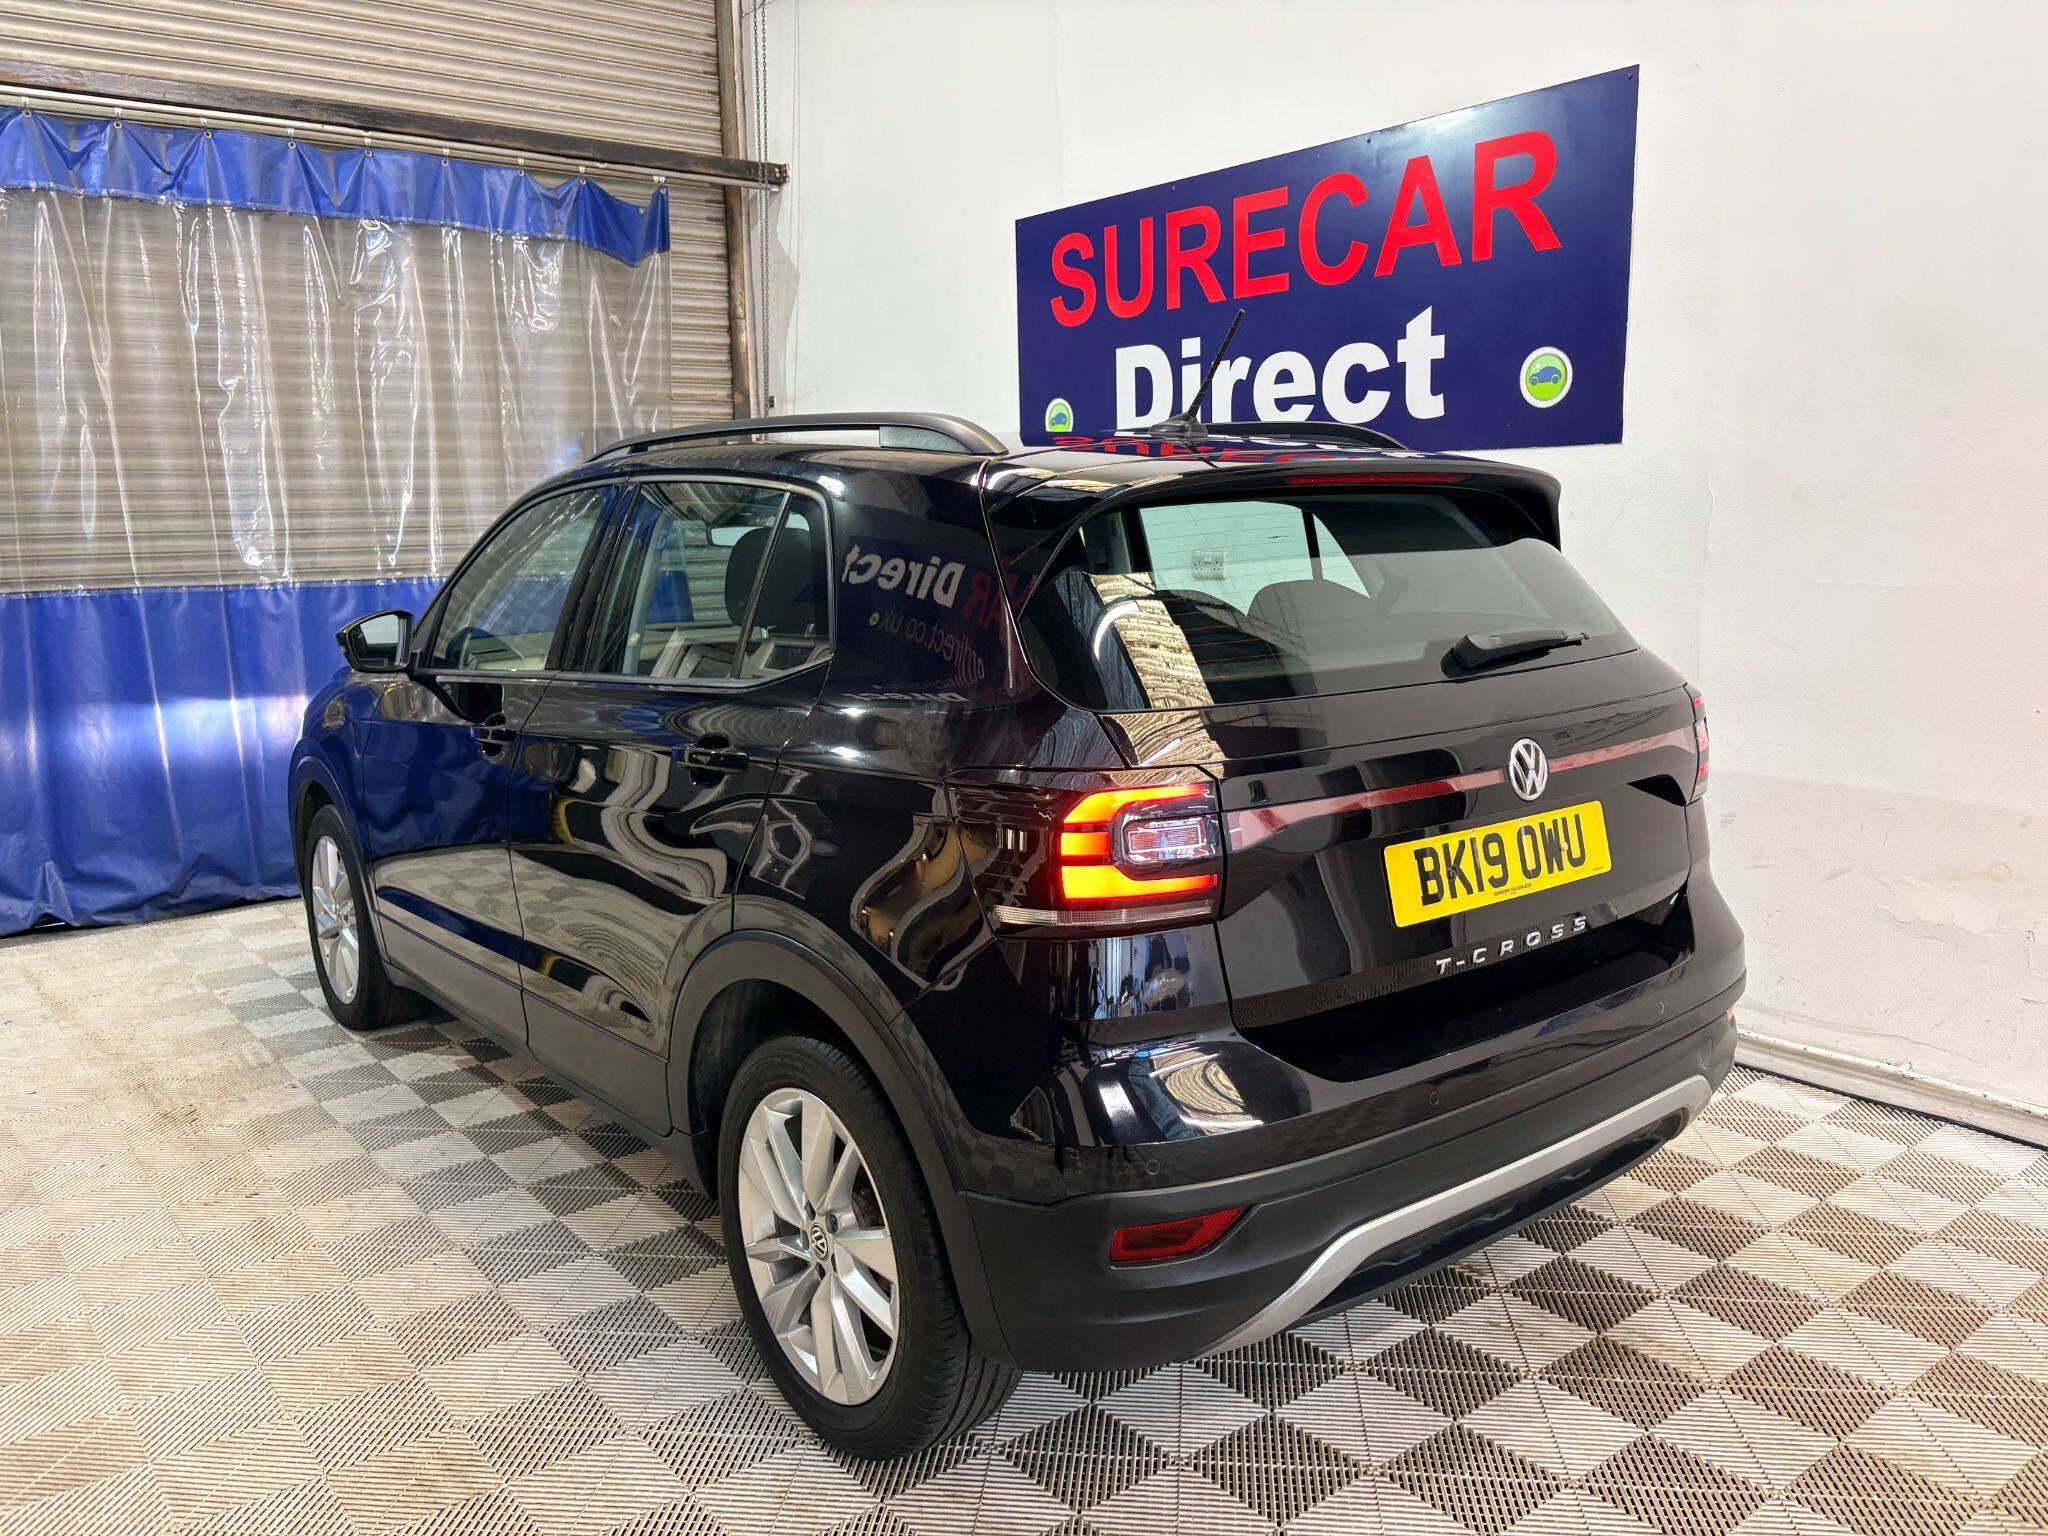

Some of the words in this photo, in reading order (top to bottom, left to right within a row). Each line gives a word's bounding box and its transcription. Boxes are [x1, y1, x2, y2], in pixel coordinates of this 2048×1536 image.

[1050, 130, 1562, 328] SURECAR
[1115, 305, 1446, 427] Direct
[1414, 832, 1509, 906] BK19
[1516, 813, 1587, 880] OWU
[1435, 915, 1588, 975] T-CROSS
